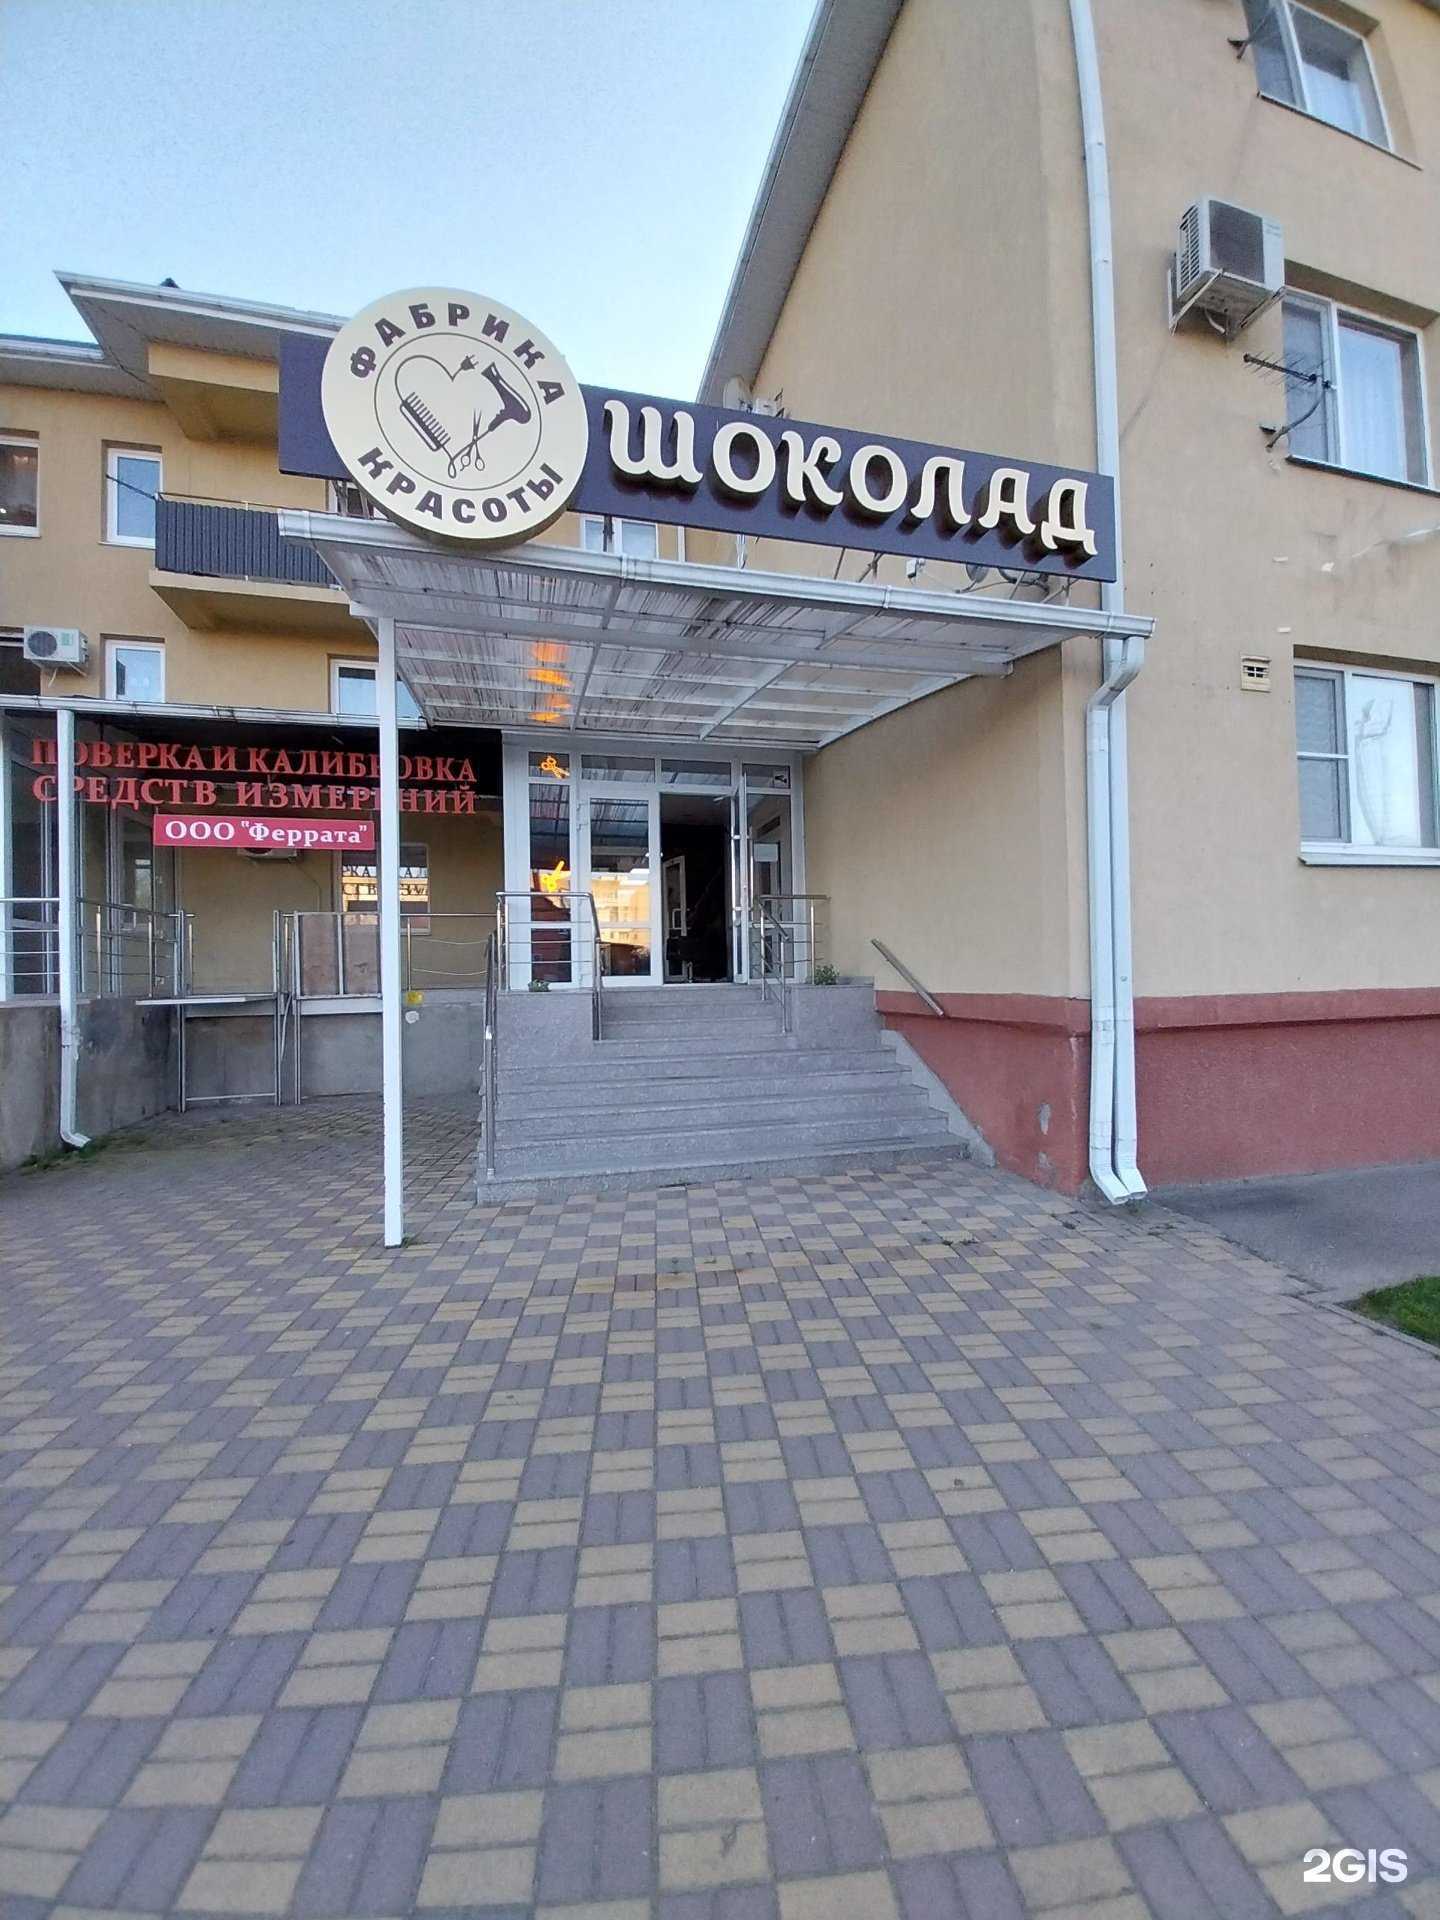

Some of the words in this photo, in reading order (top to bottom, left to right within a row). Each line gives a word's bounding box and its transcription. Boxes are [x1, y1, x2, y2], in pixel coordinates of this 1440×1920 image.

[349, 302, 566, 406] ФАБРИКА
[357, 446, 565, 525] КРАСОТЫ
[603, 399, 1098, 556] ШОКОЛАД
[31, 737, 206, 771] ПОВЕРКА
[211, 744, 238, 772] И
[165, 820, 235, 841] ООО
